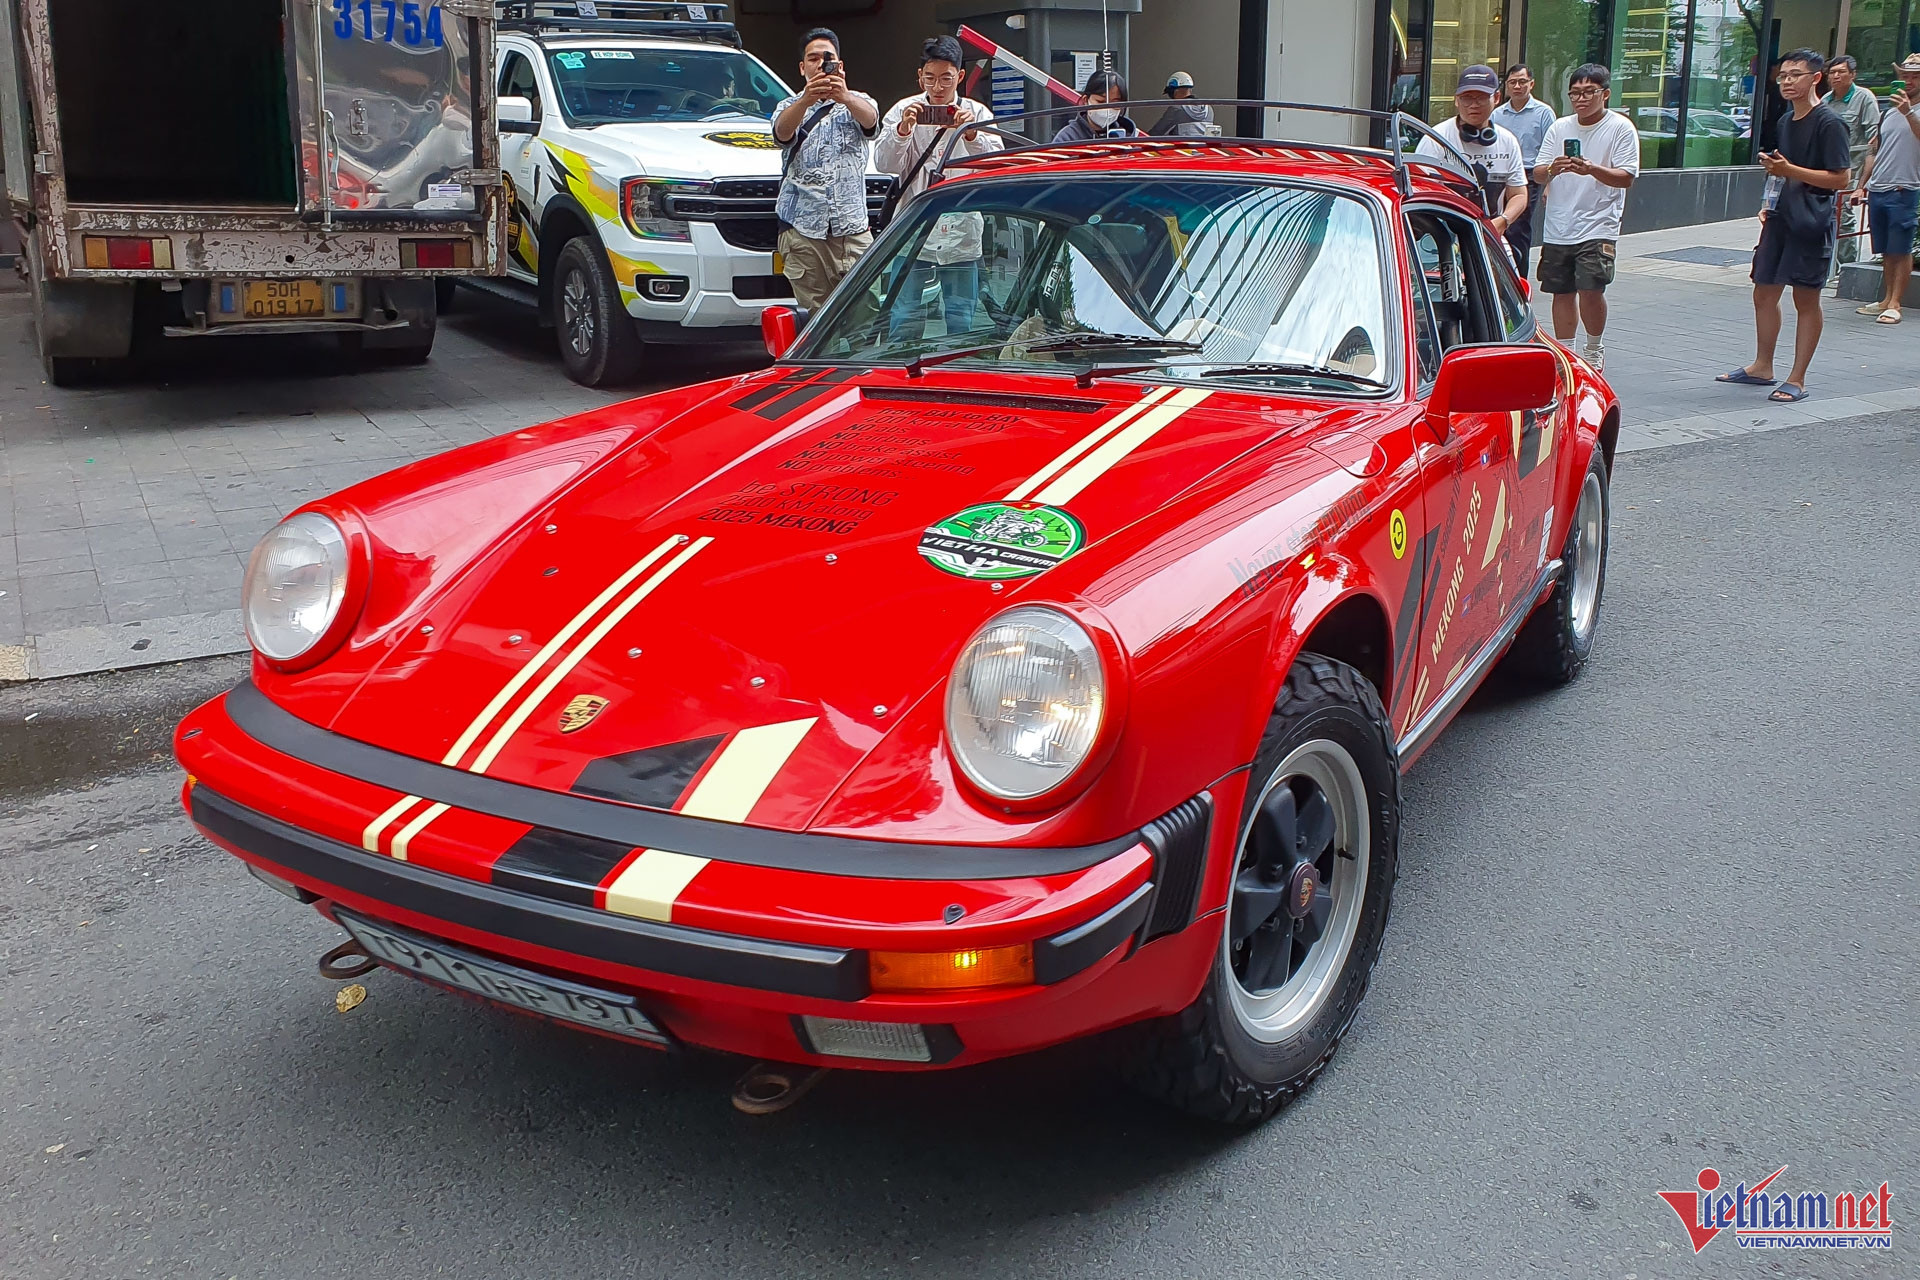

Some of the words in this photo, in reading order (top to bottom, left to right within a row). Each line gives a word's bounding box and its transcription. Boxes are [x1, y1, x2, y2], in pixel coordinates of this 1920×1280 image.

[333, 0, 443, 47] 31754
[266, 283, 300, 297] 50H
[922, 409, 961, 417] BAY
[984, 414, 1024, 423] BAY
[829, 432, 861, 440] NO
[844, 423, 877, 431] NO
[876, 425, 910, 434] abs
[964, 422, 1012, 432] DAY
[811, 441, 845, 450] NO
[843, 443, 898, 453] brake
[901, 449, 962, 460] assist
[777, 460, 811, 470] NO
[794, 450, 828, 459] NO
[823, 453, 888, 464] power
[892, 459, 976, 475] steering
[739, 480, 776, 495] be
[780, 482, 899, 506] STRONG
[718, 495, 776, 508] 2500
[813, 503, 874, 521] along
[698, 508, 761, 523] 2025
[755, 513, 859, 534] MEKONG
[1431, 555, 1465, 665] MEKONG
[1463, 481, 1482, 556] 2025
